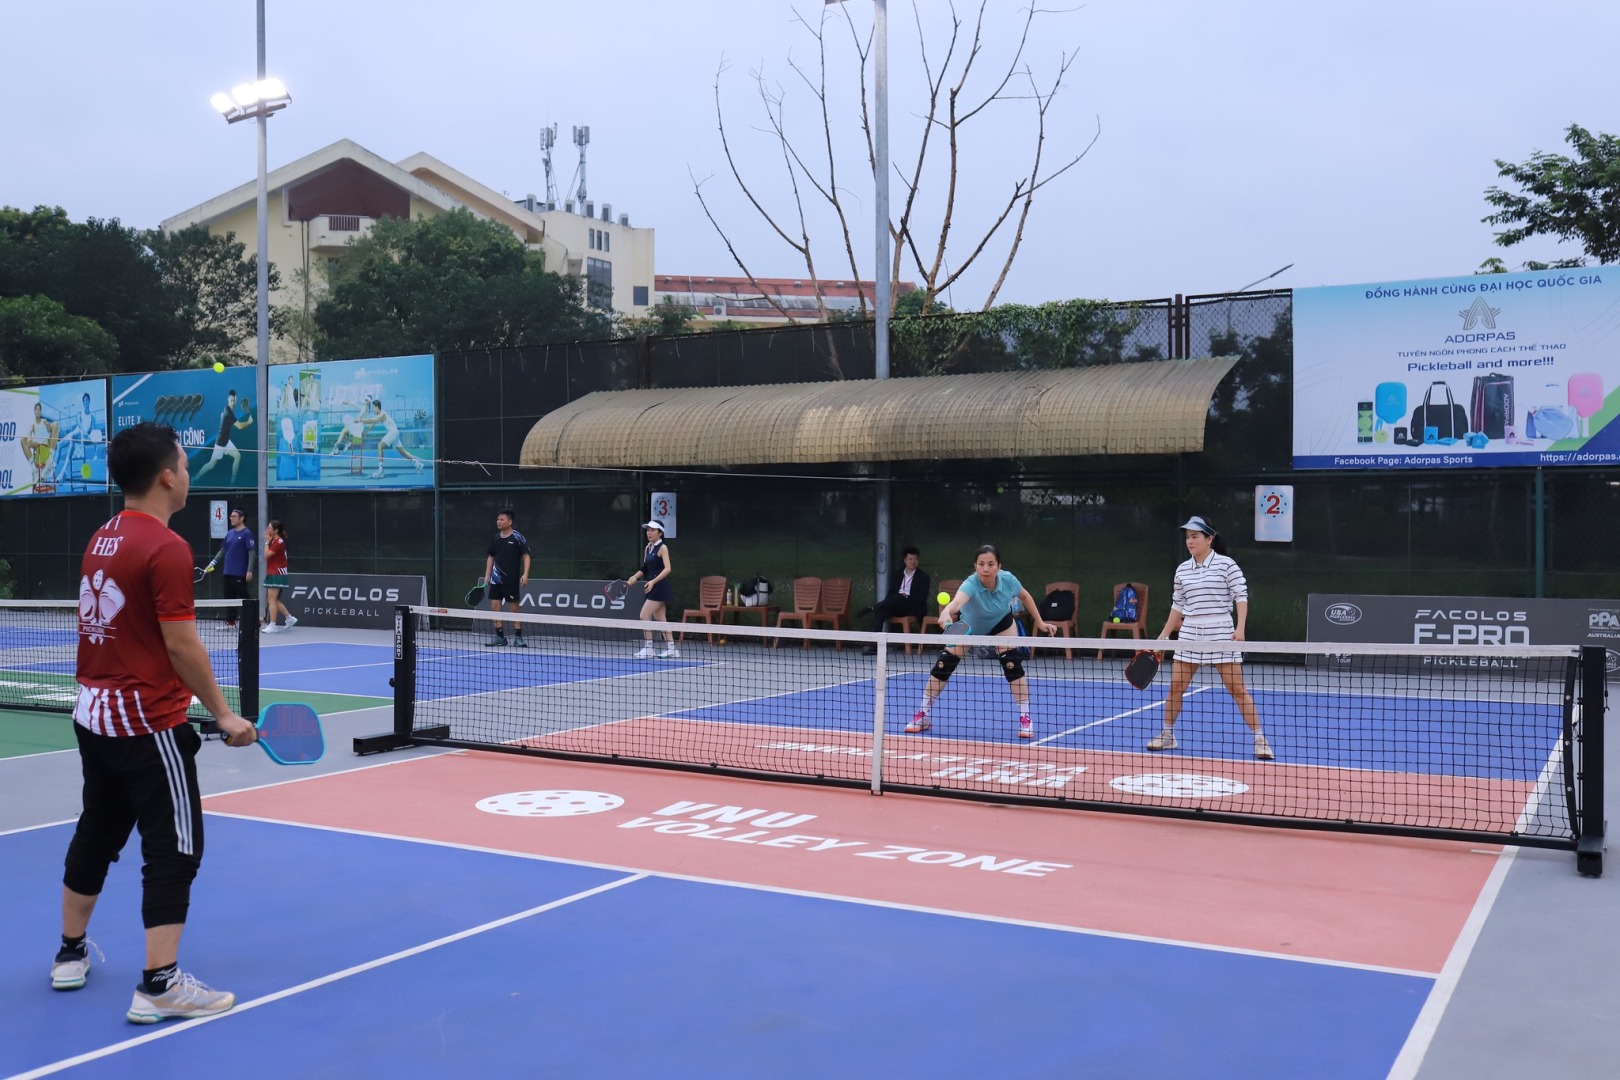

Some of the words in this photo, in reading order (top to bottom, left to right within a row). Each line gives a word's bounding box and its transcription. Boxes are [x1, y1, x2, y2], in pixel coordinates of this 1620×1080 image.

[1403, 285, 1438, 297] HÀNH
[1441, 283, 1476, 294] CÙNG
[1480, 282, 1502, 293] ĐẠI
[1506, 280, 1533, 292] HỌC
[1537, 274, 1575, 288] QUỐC
[1579, 275, 1602, 285] GIA
[1444, 331, 1516, 344] ADORPAS
[1408, 360, 1472, 372] Pickleball
[1476, 359, 1502, 368] and
[1508, 356, 1554, 368] more!!!
[118, 416, 135, 426] ELITE
[183, 427, 205, 446] CÔNG
[1334, 456, 1376, 465] Facebook
[1378, 456, 1402, 466] Page:
[1404, 456, 1441, 465] Adorpas
[1443, 455, 1473, 465] Sports
[658, 500, 668, 516] 3
[1266, 494, 1280, 515] 2
[216, 508, 222, 520] 4
[291, 586, 400, 602] FACOLOS
[502, 593, 626, 610] ACOLOS
[304, 608, 380, 617] PICKLEBALL
[1414, 610, 1527, 622] FACOLOS
[1589, 612, 1620, 626] PPA
[1414, 624, 1530, 646] F-PRO
[1423, 656, 1518, 668] PICKLEBALL
[652, 800, 818, 828] VNU
[616, 816, 870, 851] VOLLEY
[853, 845, 1074, 876] ZONE
